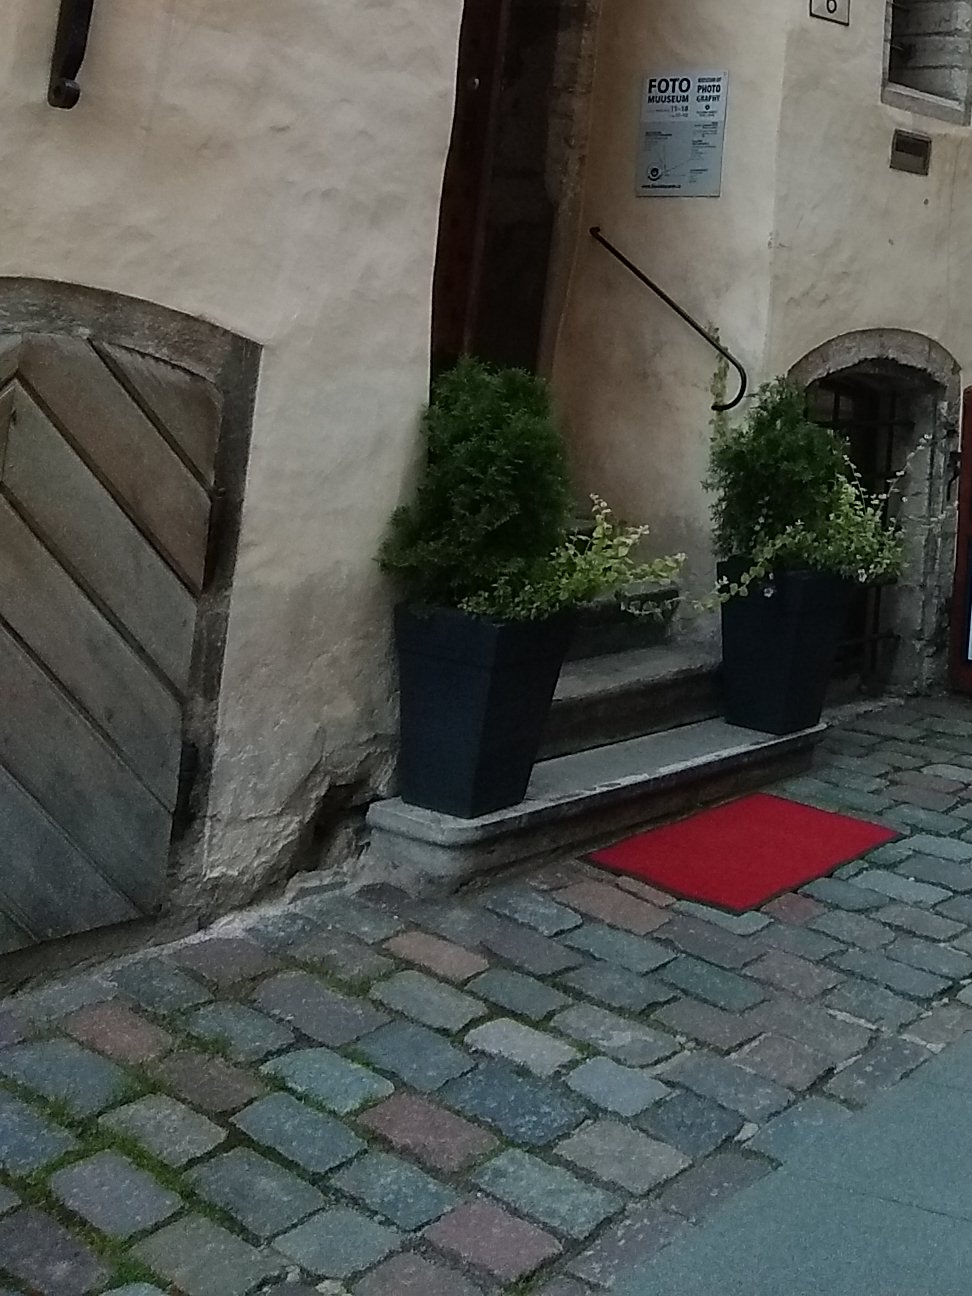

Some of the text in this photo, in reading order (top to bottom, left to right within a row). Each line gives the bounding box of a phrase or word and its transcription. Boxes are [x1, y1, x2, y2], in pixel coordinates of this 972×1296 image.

[647, 77, 691, 94] FOTO
[697, 84, 721, 94] PHOTO
[647, 94, 689, 104] MUUSEUM
